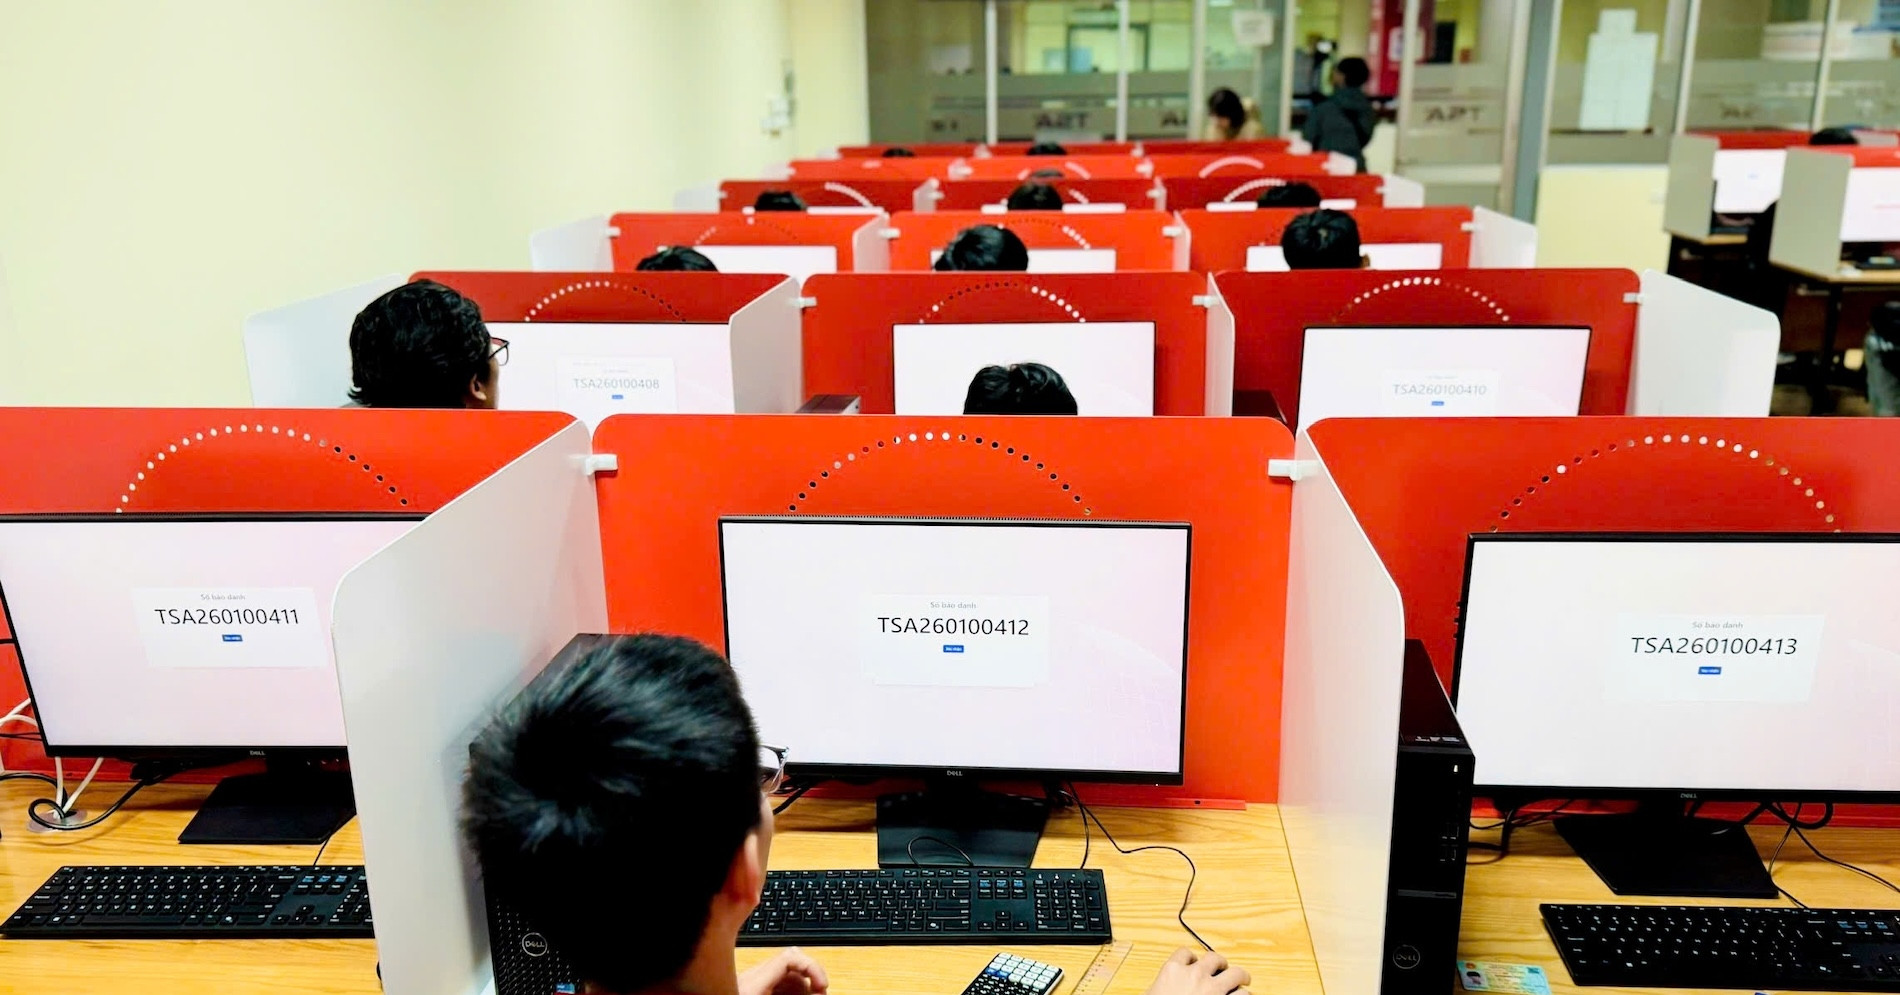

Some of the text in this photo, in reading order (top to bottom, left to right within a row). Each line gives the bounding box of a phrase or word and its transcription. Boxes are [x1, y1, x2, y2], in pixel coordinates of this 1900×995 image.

[573, 378, 660, 389] TSA260100408
[1393, 383, 1487, 395] TSA260100410
[153, 608, 299, 625] TSA260100411
[877, 617, 1029, 636] TSA260100412
[1631, 637, 1798, 655] TSA260100413
[525, 940, 545, 948] DELL
